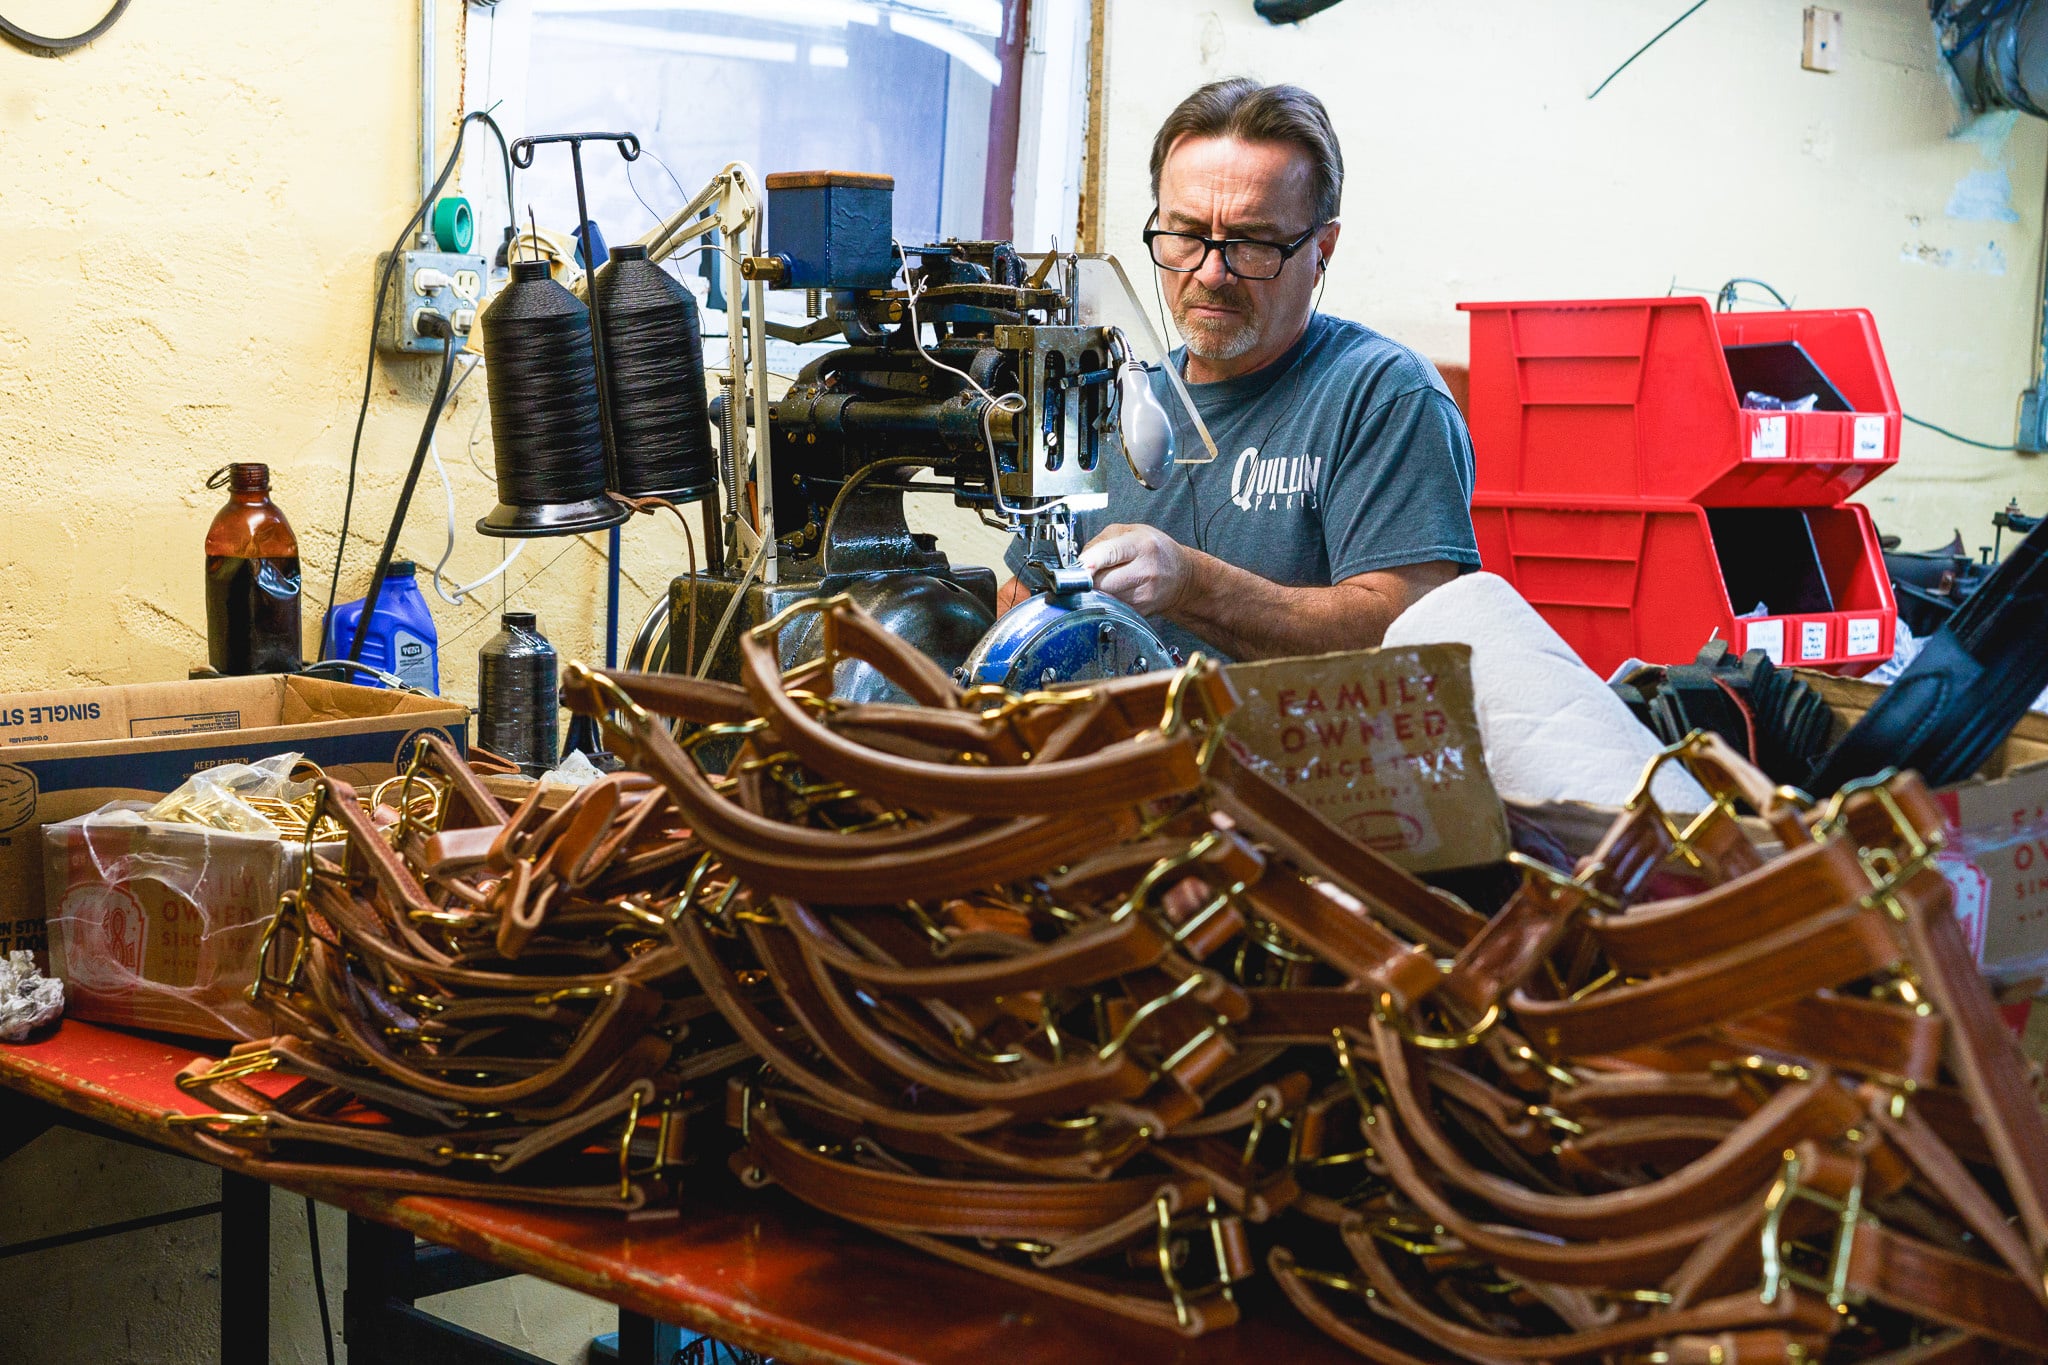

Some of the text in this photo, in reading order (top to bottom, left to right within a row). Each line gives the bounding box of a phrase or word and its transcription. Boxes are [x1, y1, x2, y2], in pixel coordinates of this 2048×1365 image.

[1231, 447, 1322, 512] QUILLIN
[1255, 493, 1318, 511] PARIS
[1278, 673, 1439, 717] FAMILY
[29, 702, 100, 724] SINGLE
[1281, 709, 1447, 754] OWNED
[193, 760, 216, 770] KEEP
